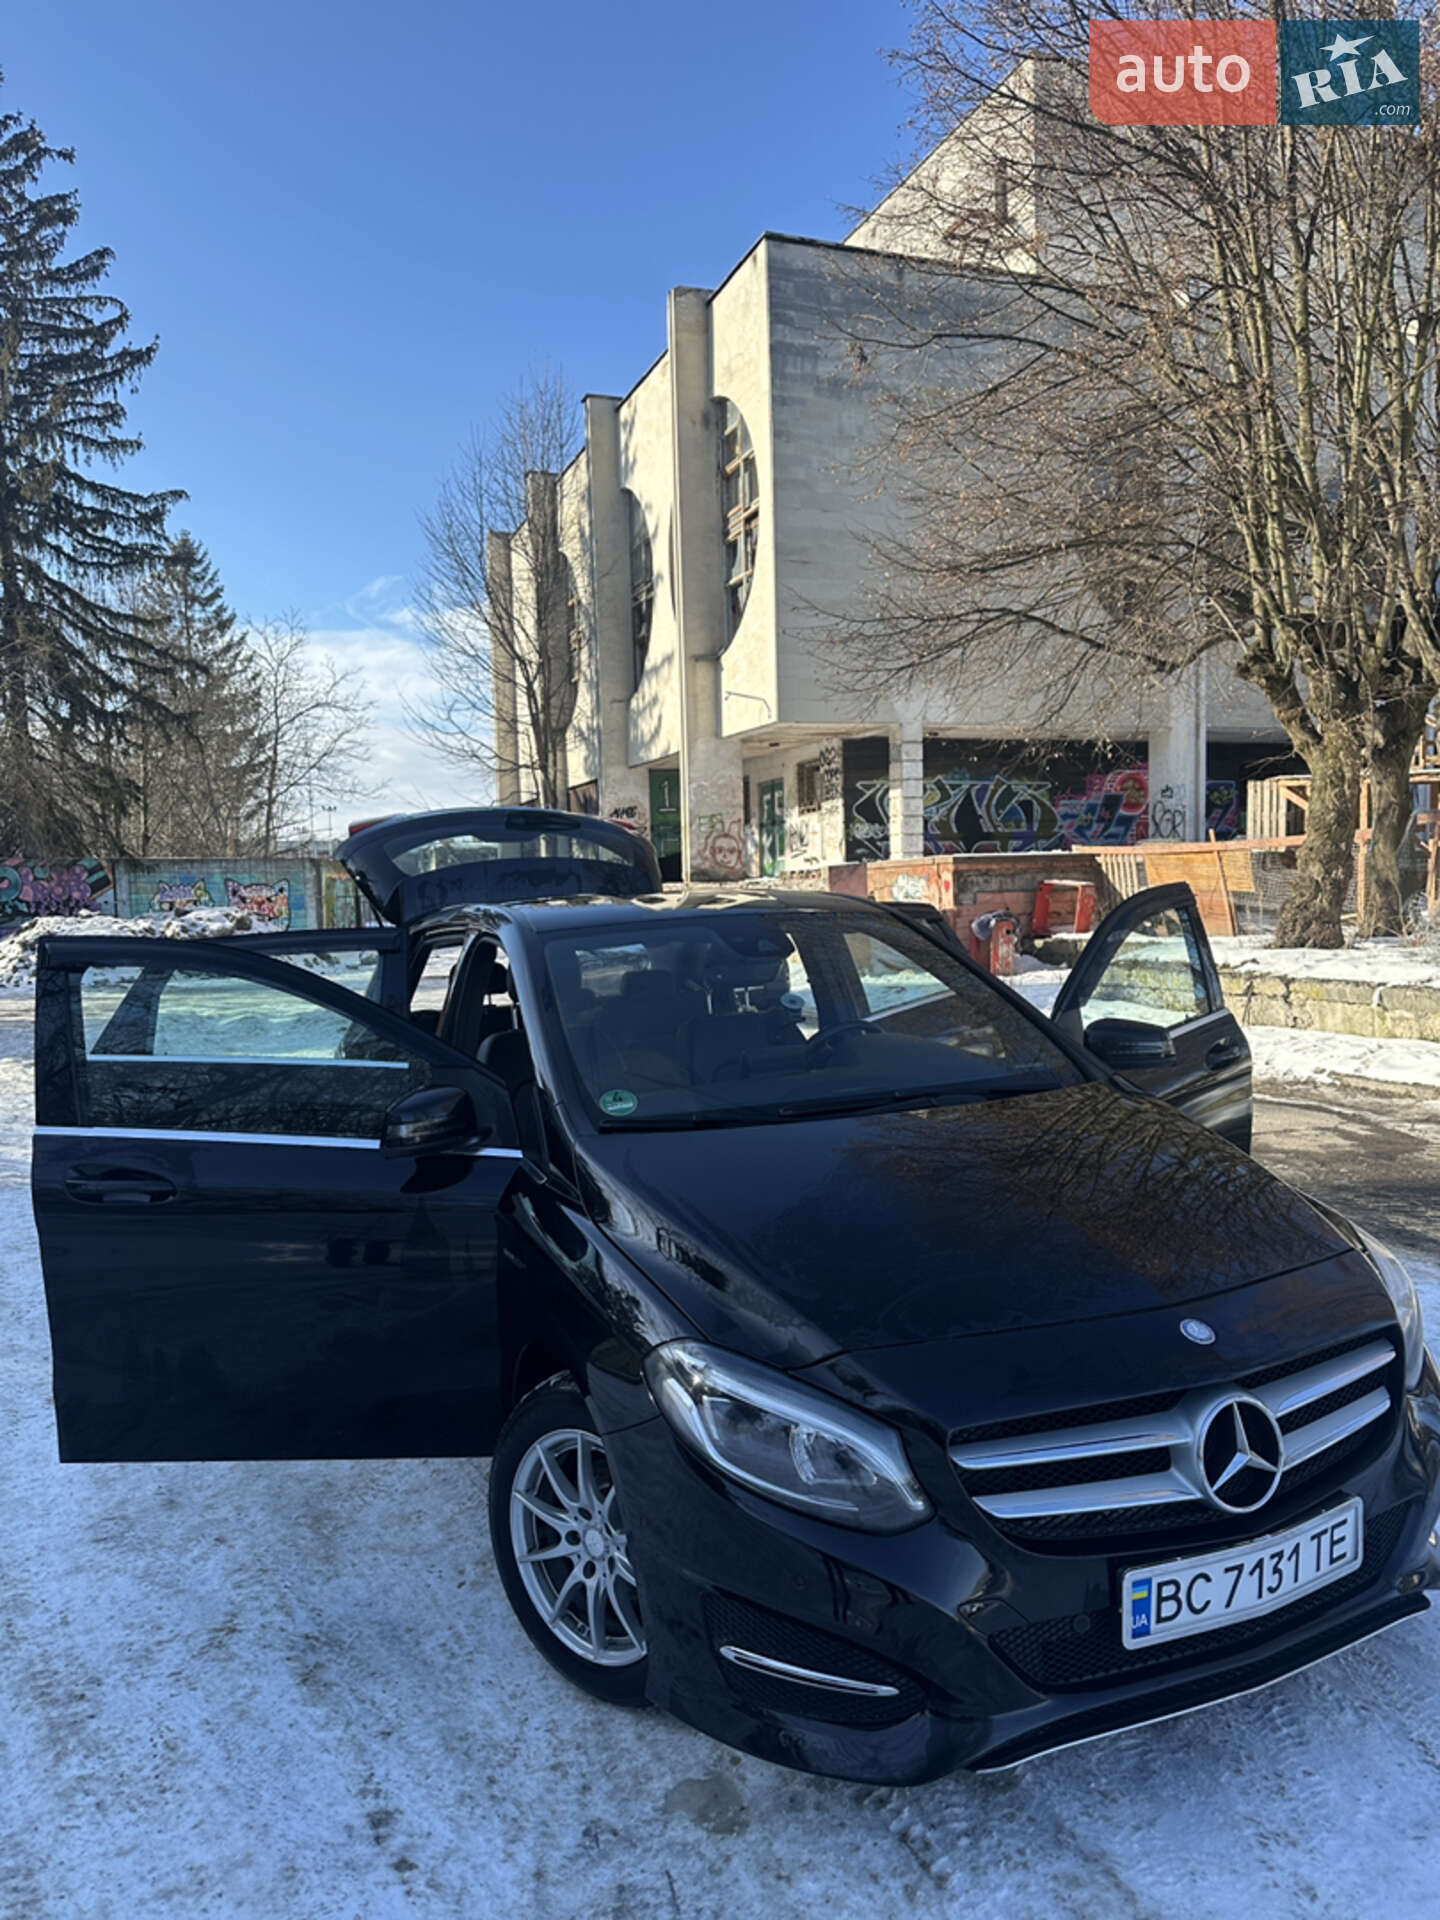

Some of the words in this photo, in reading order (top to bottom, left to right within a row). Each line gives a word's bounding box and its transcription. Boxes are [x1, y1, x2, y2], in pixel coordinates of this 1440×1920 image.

[1155, 1572, 1213, 1625] BC
[1224, 1541, 1301, 1609] 7131
[1310, 1517, 1348, 1573] TE
[1130, 1613, 1149, 1629] UA
